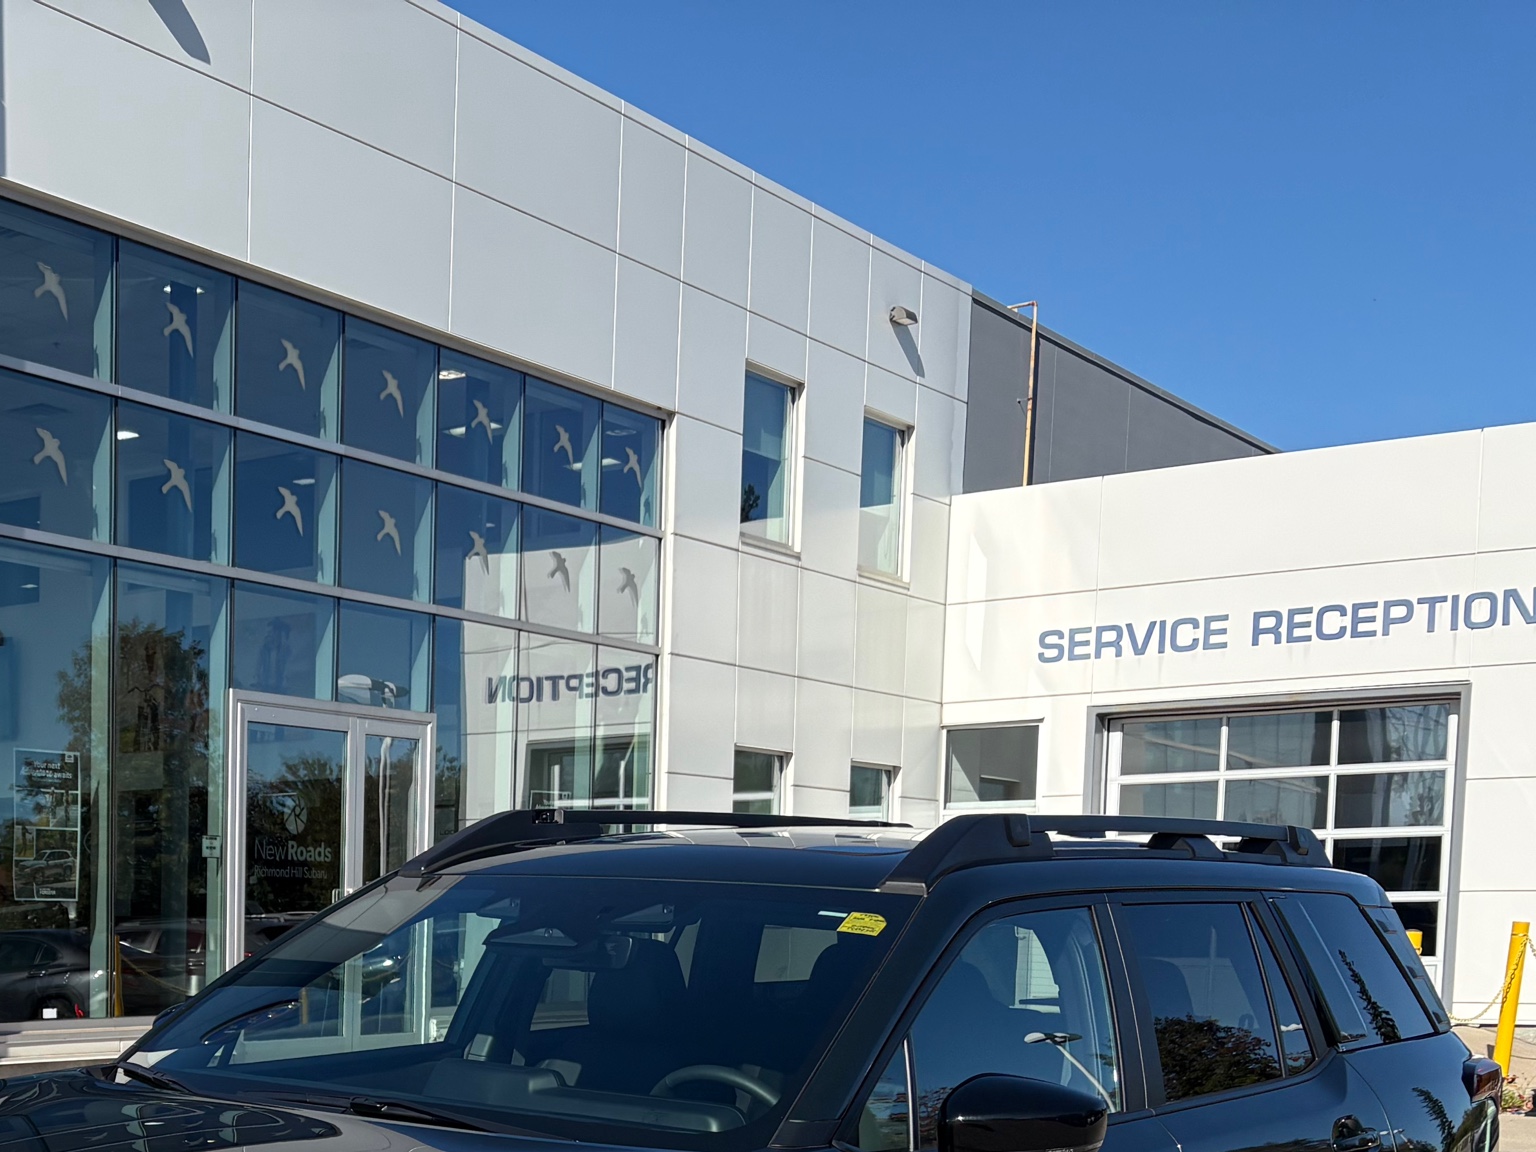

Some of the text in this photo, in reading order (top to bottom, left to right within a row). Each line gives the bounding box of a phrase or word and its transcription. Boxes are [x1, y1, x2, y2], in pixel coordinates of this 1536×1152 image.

[1037, 586, 1536, 664] SERVICE RECEPTION
[254, 865, 290, 878] Richmond
